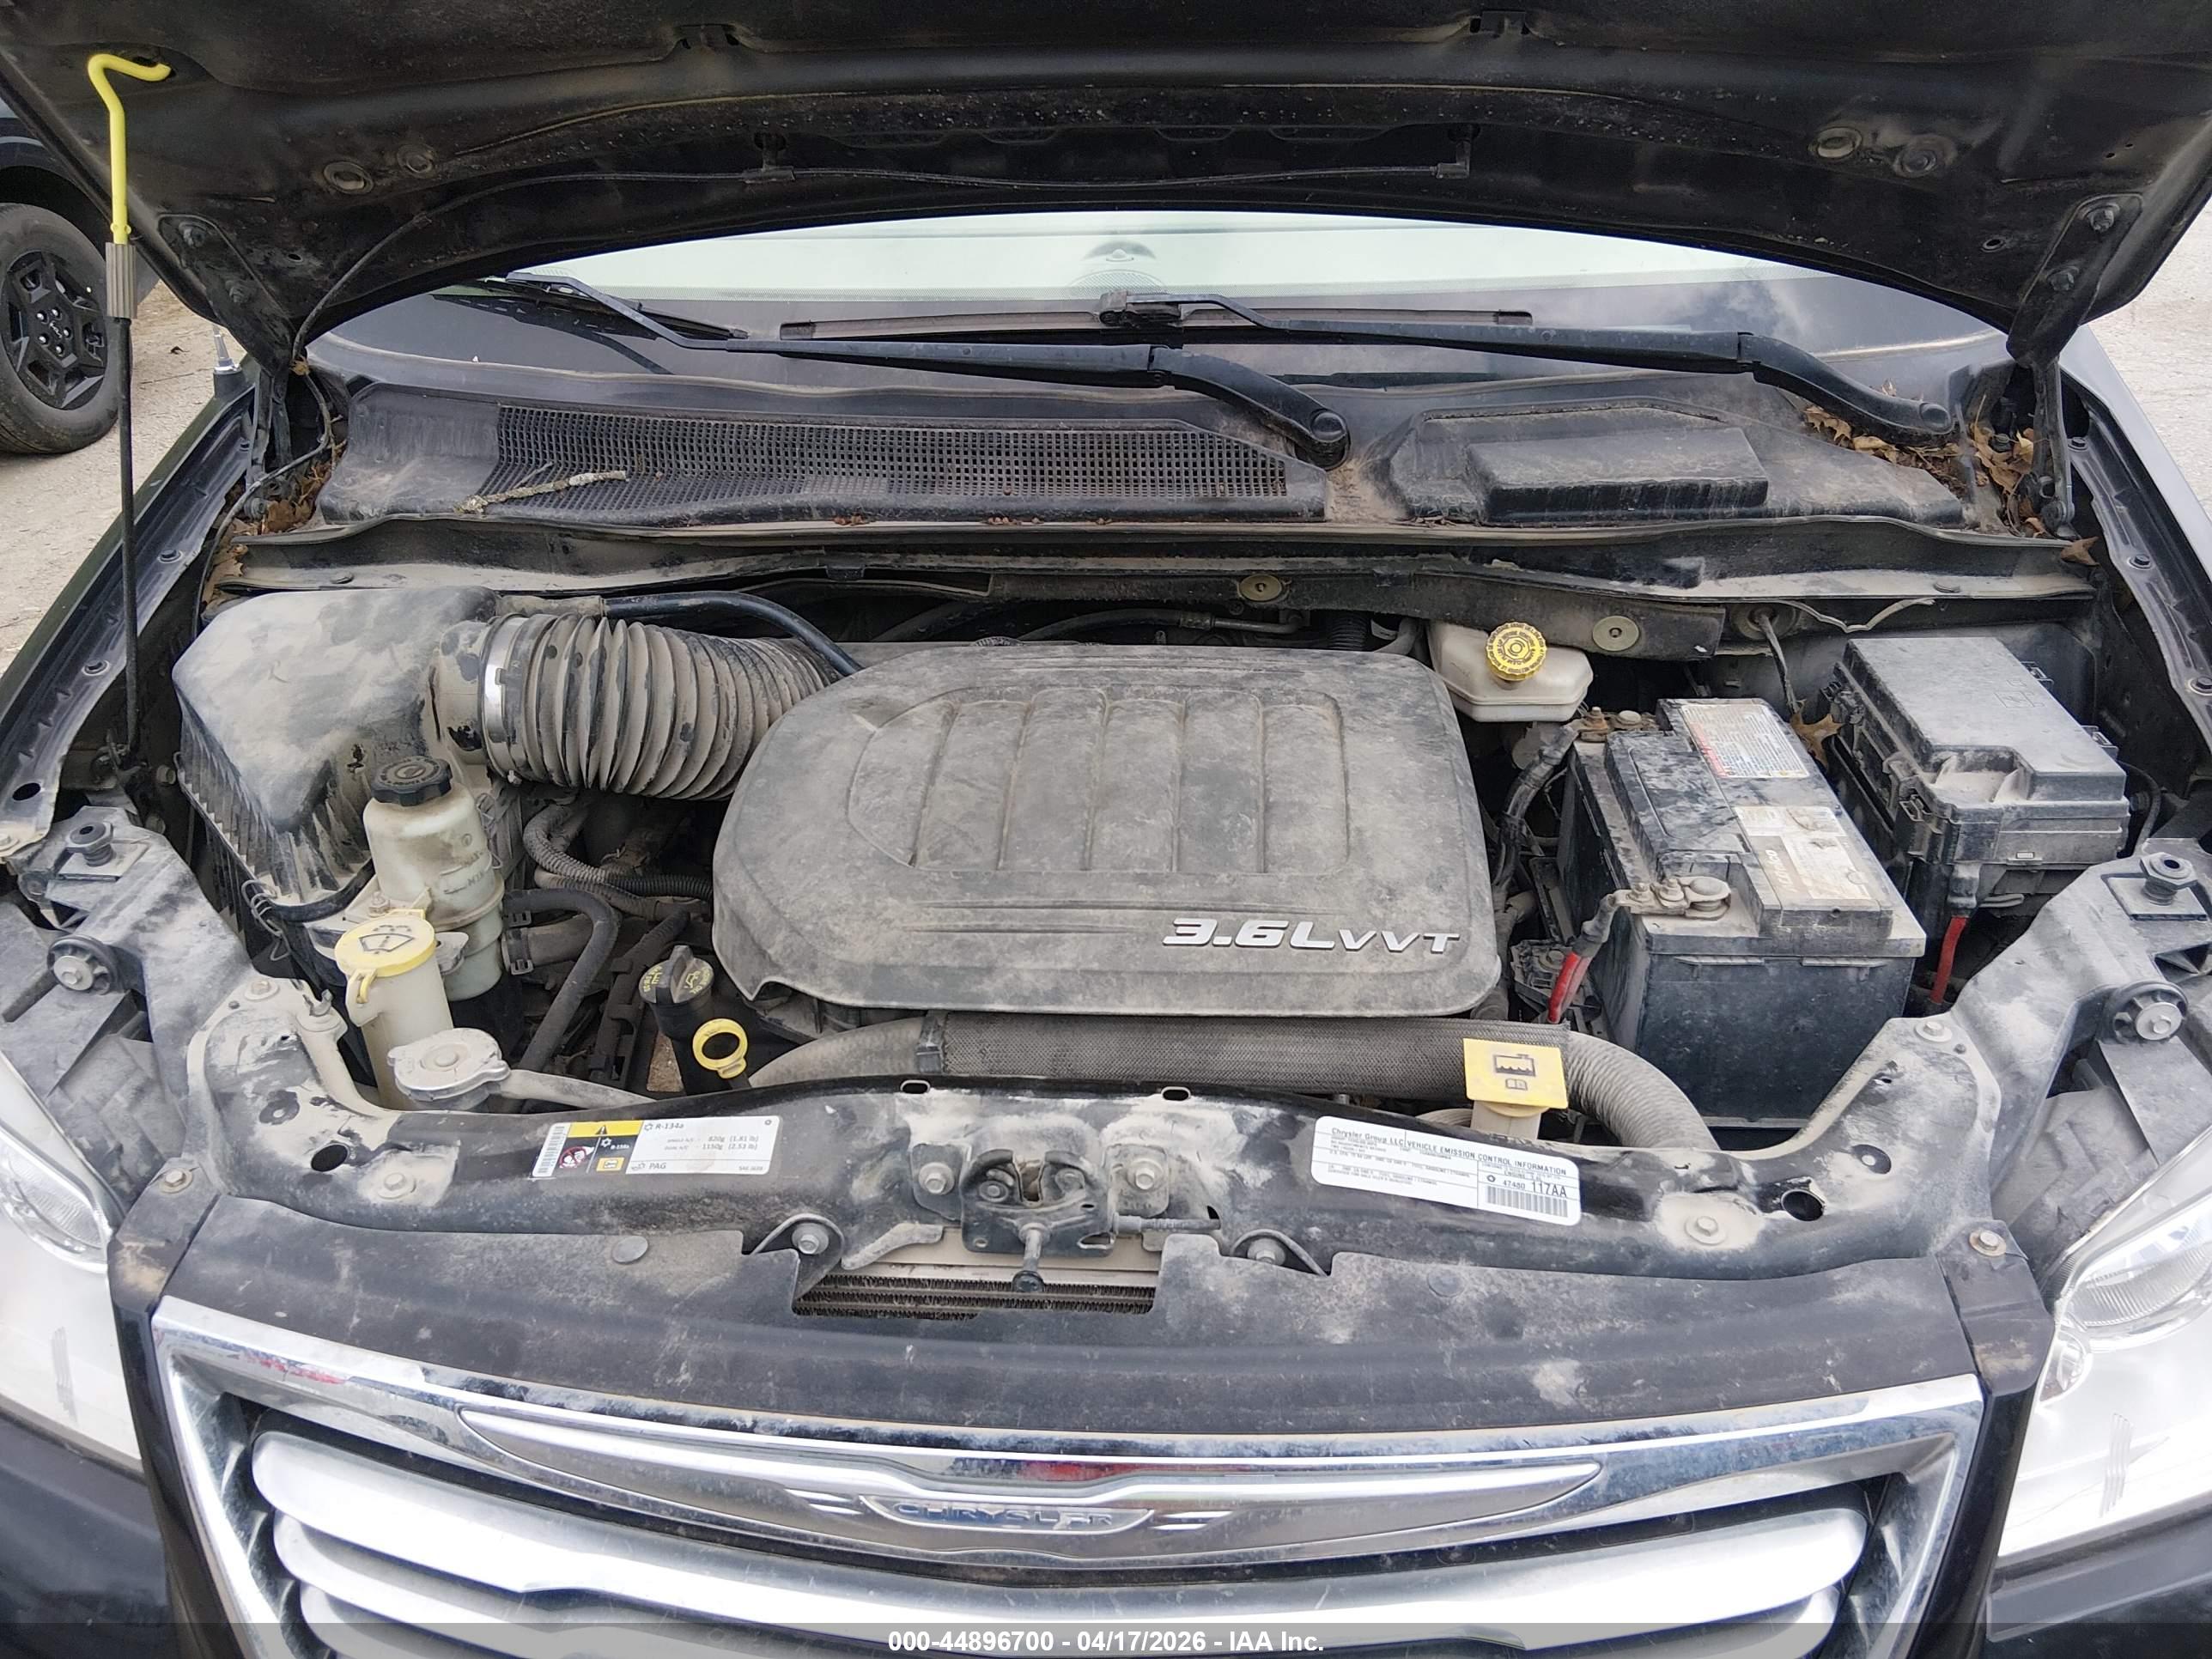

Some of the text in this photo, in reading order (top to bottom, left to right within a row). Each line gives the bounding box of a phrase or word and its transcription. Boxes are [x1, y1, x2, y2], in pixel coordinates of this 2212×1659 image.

[1162, 917, 1460, 954] 3.6L VVT
[1332, 1127, 1363, 1139] Chrysler
[1365, 1133, 1387, 1144] Group
[1407, 1140, 1437, 1152] VEHICLE
[1440, 1147, 1475, 1159] EMISSION
[1478, 1153, 1512, 1165] CONTROL
[1515, 1161, 1566, 1176] INFORMATION
[1531, 1181, 1567, 1198] 117AA
